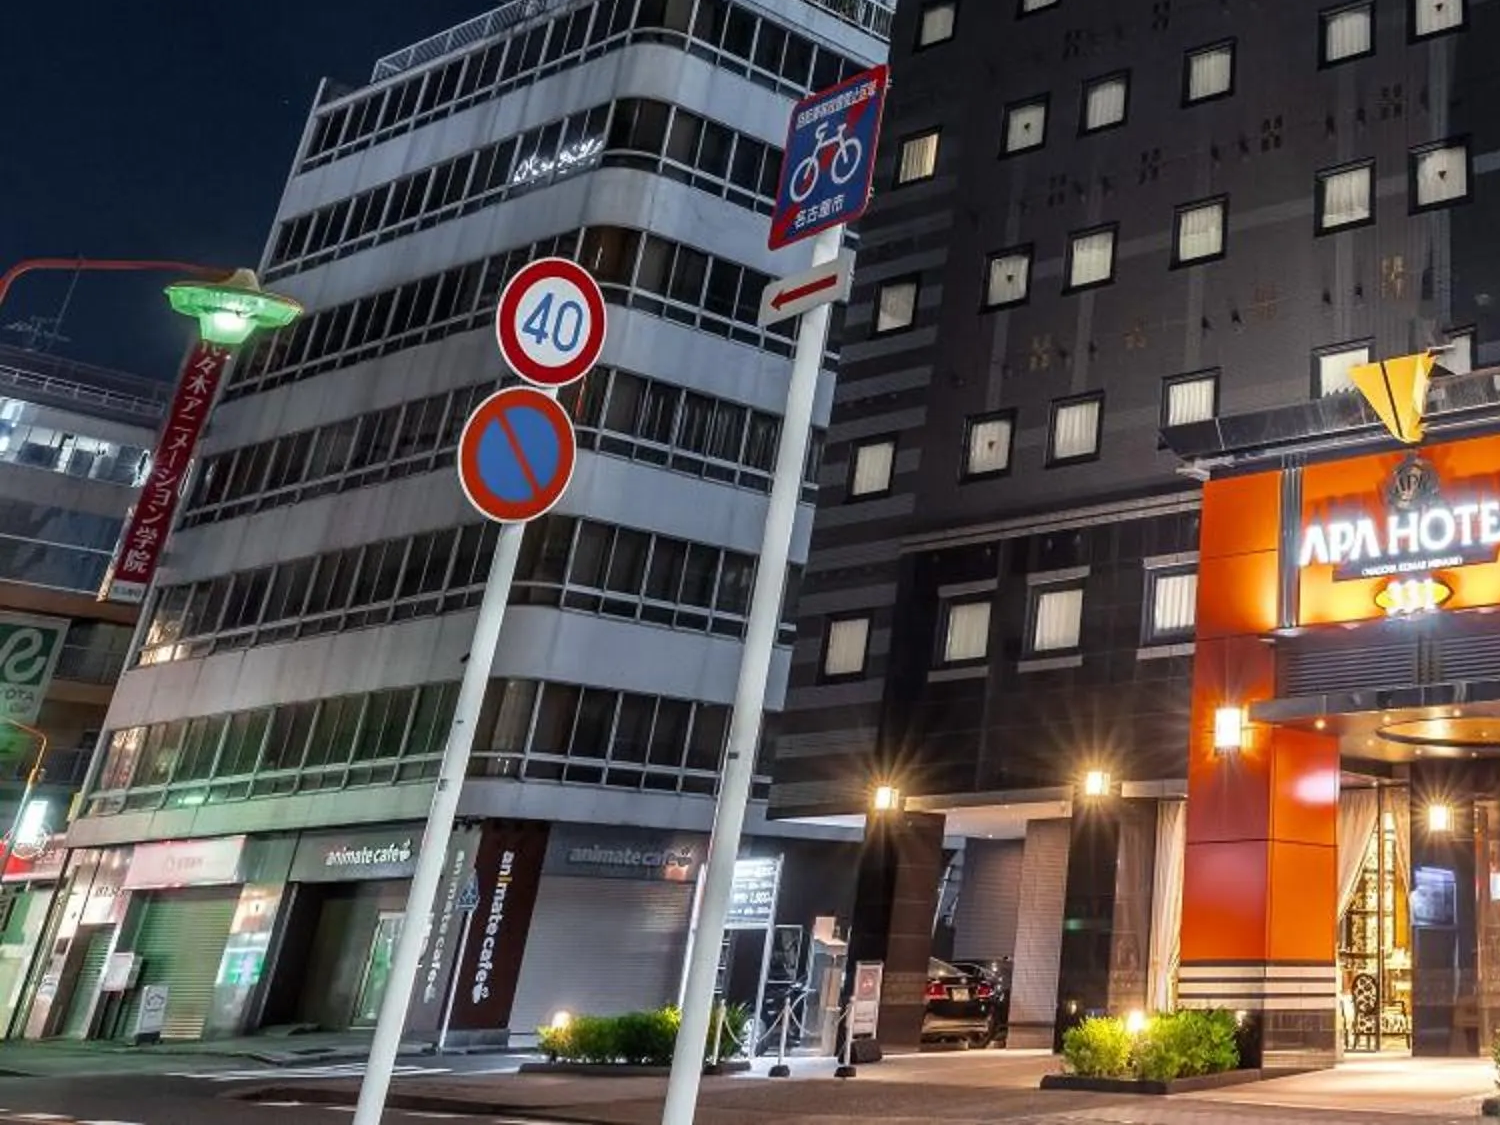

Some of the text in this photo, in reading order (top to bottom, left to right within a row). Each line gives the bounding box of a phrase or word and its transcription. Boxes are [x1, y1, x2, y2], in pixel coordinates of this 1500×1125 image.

[794, 194, 845, 230] 名古屋市
[522, 292, 583, 352] 40
[1297, 518, 1382, 567] APA
[325, 843, 403, 866] animate cafe
[569, 844, 676, 866] animate cafe
[475, 850, 515, 983] animate cafe
